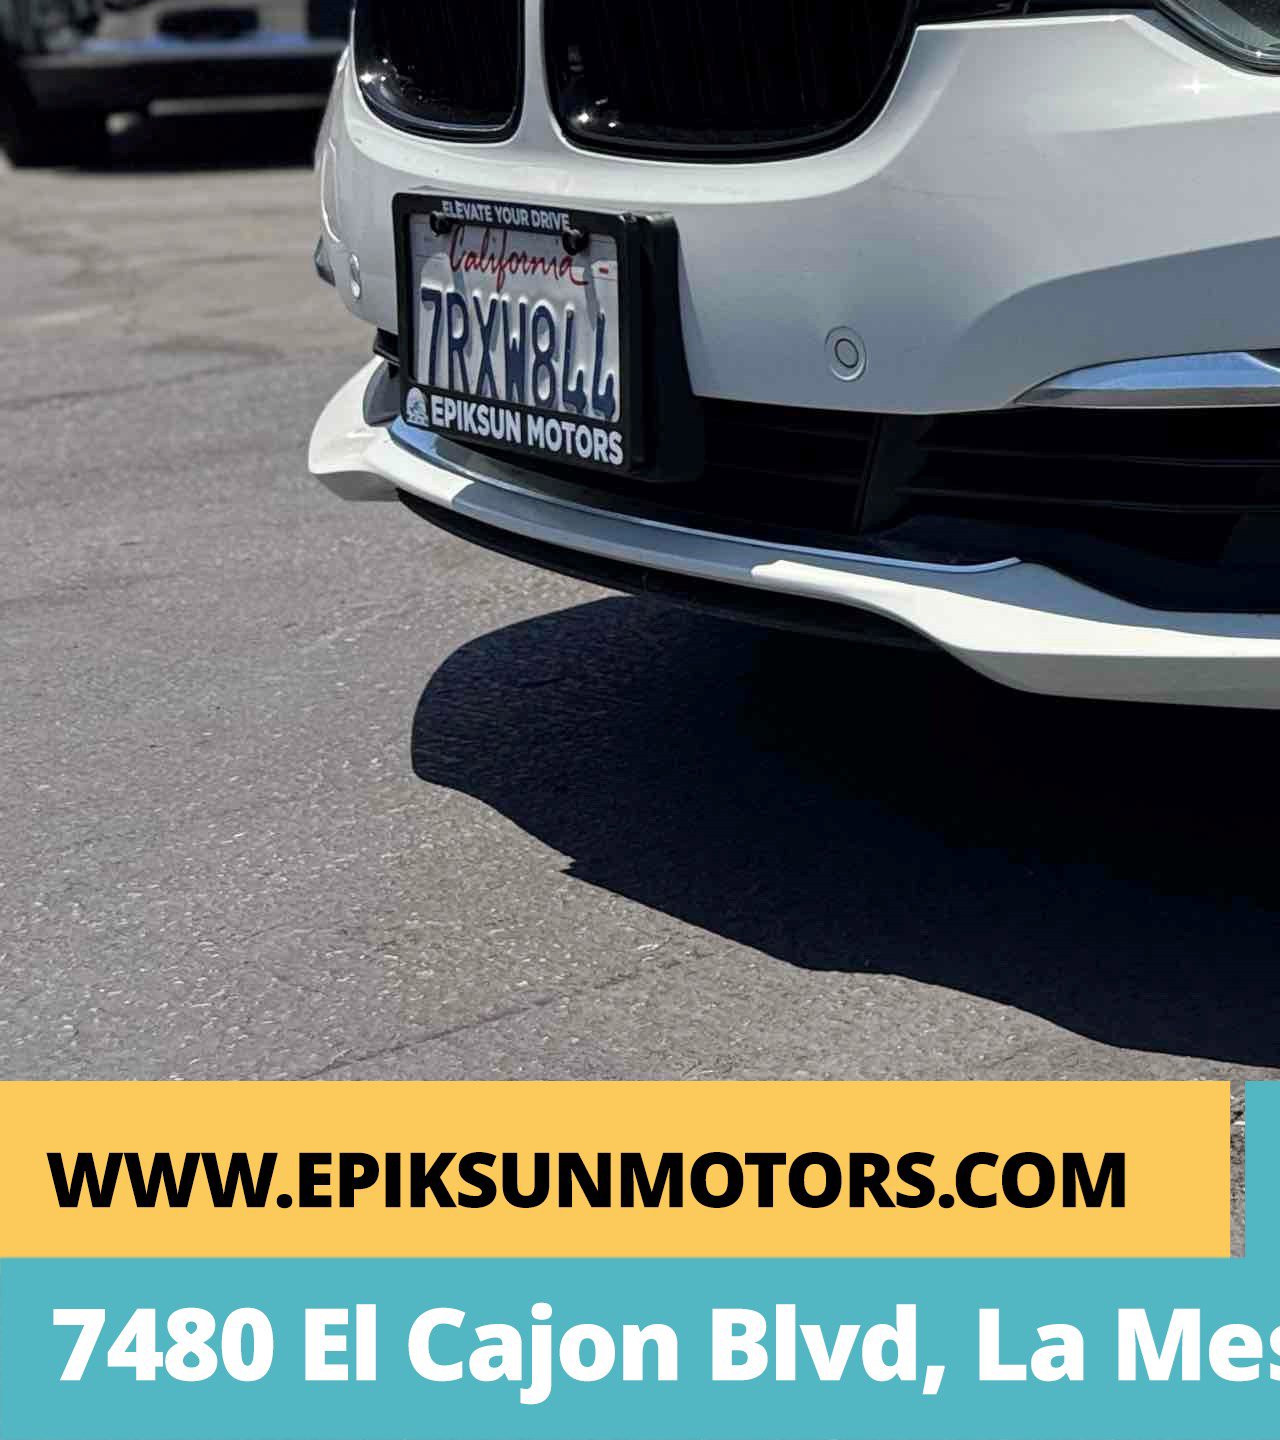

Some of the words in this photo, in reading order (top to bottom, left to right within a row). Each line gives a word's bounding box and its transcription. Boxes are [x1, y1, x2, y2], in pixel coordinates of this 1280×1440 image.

[441, 200, 493, 223] ELEVATE
[494, 206, 529, 227] YOUR
[531, 210, 571, 231] DRIVE
[449, 225, 589, 291] California
[420, 287, 616, 423] 7RXW844
[430, 394, 522, 444] EPIKSUN
[527, 416, 624, 466] MOTORS
